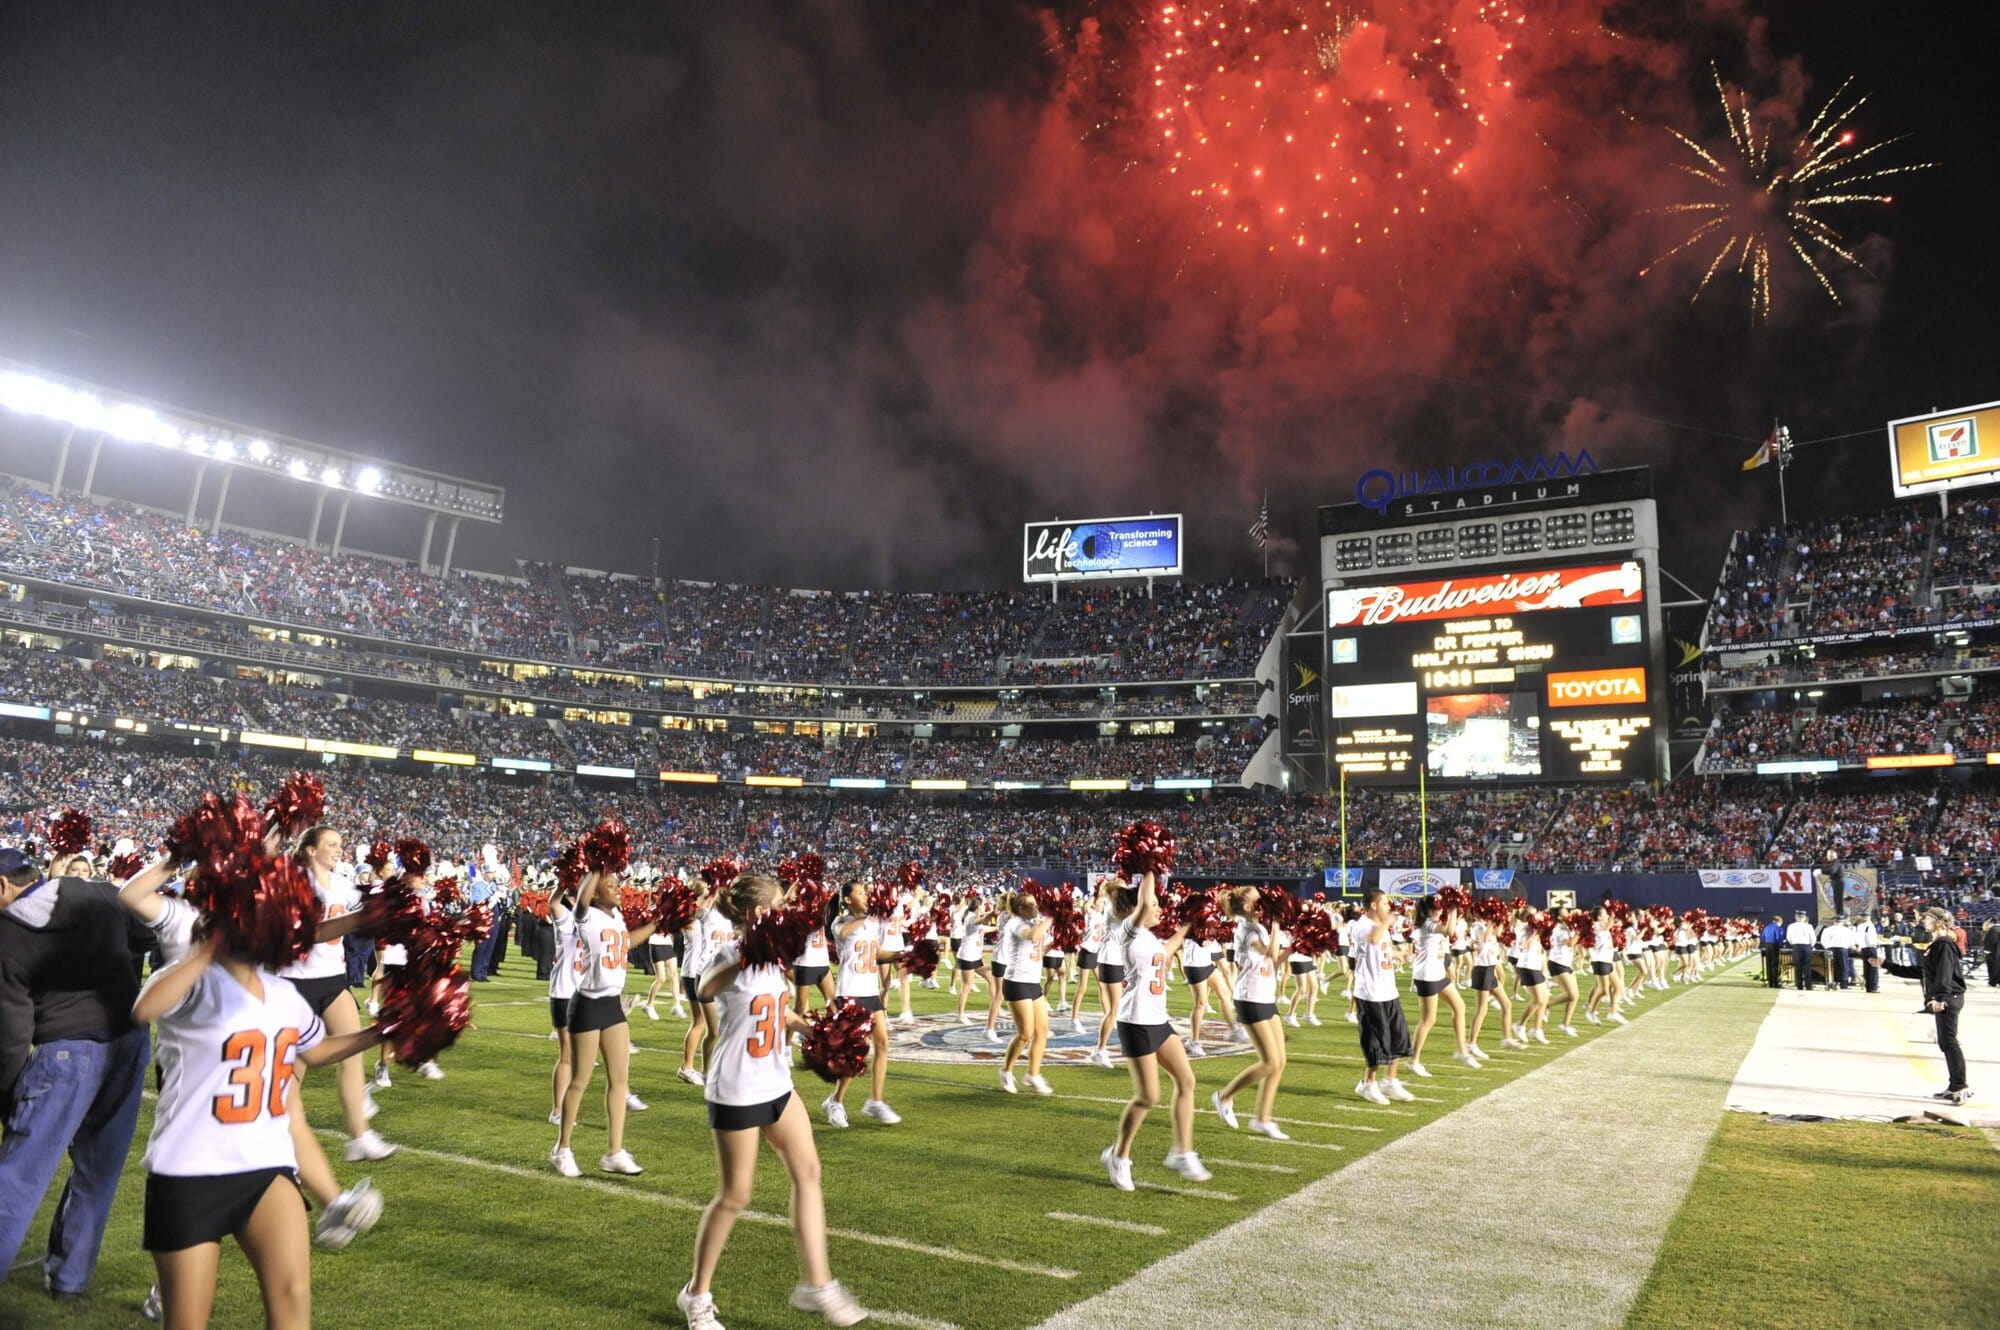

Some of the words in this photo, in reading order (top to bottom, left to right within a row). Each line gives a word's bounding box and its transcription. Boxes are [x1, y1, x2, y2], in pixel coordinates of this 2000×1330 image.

[1356, 449, 1598, 516] QUALCOMM
[1405, 484, 1580, 514] STADIUM
[1110, 529, 1173, 541] Transforming
[1123, 539, 1158, 549] science
[1029, 528, 1078, 572] life
[1361, 573, 1561, 626] Budweiser
[1495, 617, 1513, 631] TO
[1896, 627, 1927, 635] OCATION
[1434, 635, 1458, 651] DR
[1462, 631, 1524, 649] PEPPER
[1552, 677, 1641, 699] TOYOTA
[1669, 670, 1702, 686] Sprin
[1289, 692, 1320, 706] Sprint
[1778, 871, 1804, 892] N
